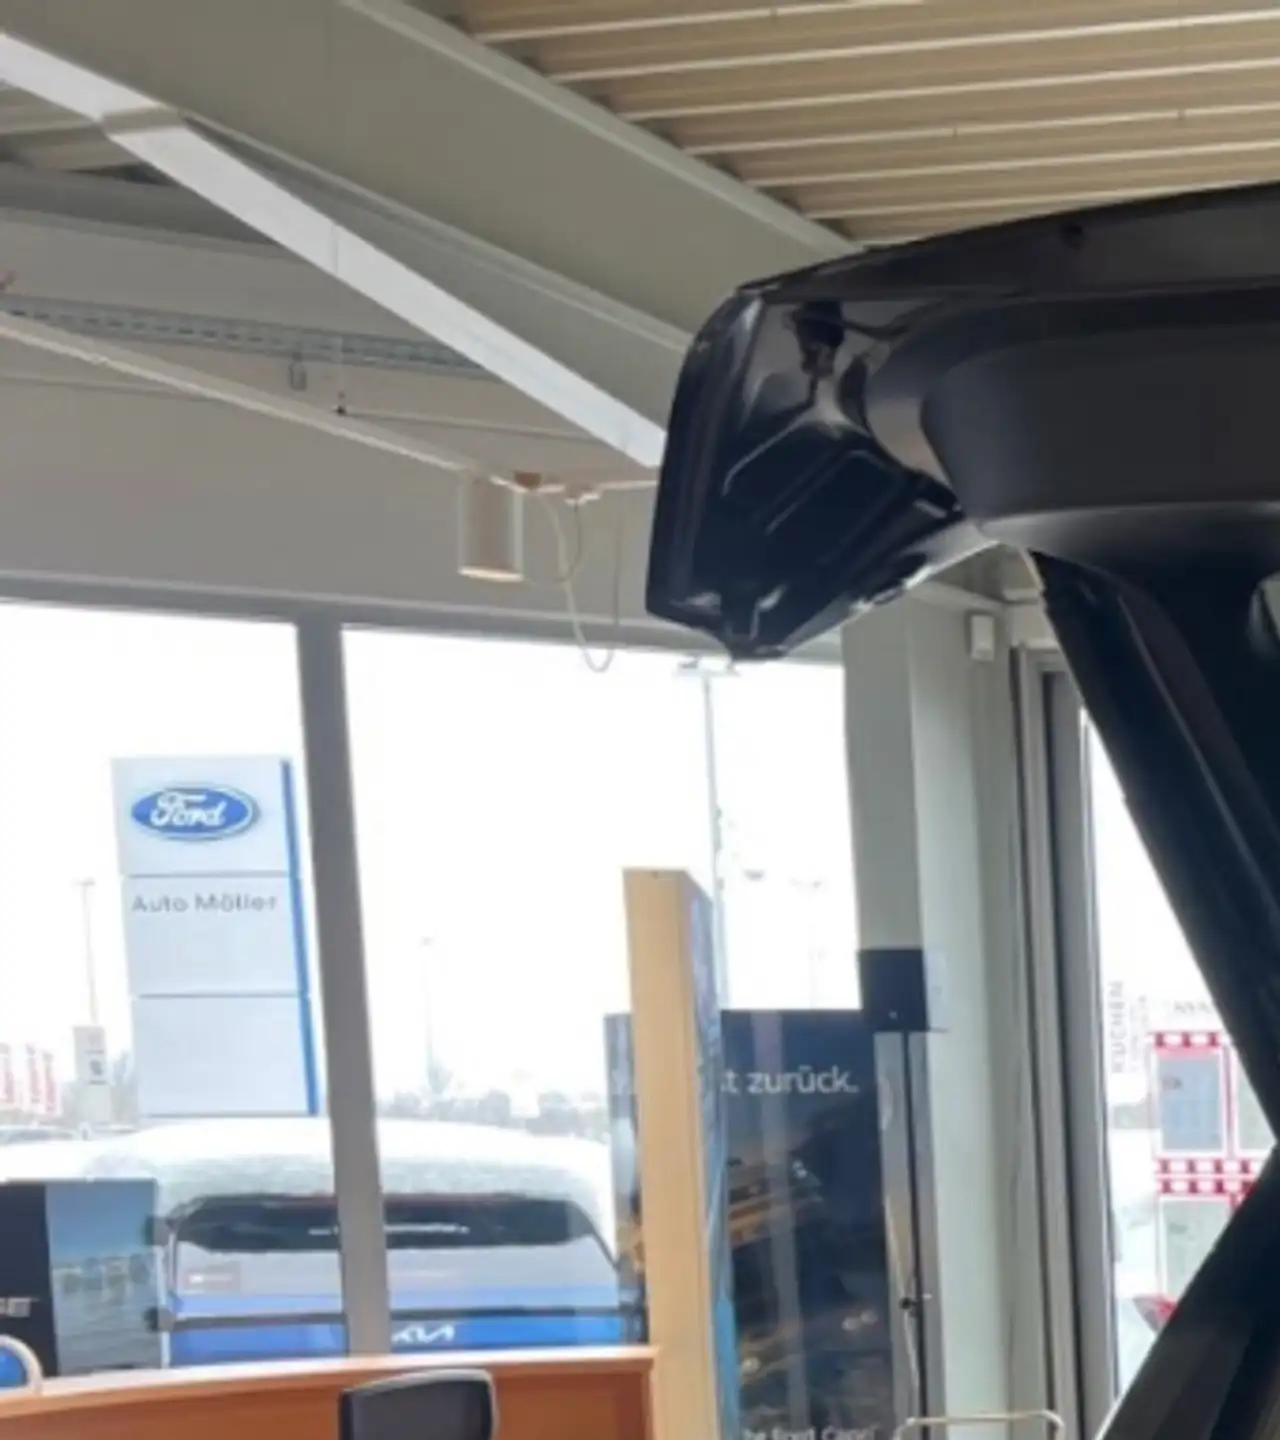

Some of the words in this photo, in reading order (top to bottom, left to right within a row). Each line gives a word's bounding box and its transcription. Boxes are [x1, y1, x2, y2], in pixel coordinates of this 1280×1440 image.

[151, 791, 228, 827] Ford
[131, 895, 190, 913] Auto
[194, 892, 278, 914] Möller
[746, 1064, 860, 1095] zurück.
